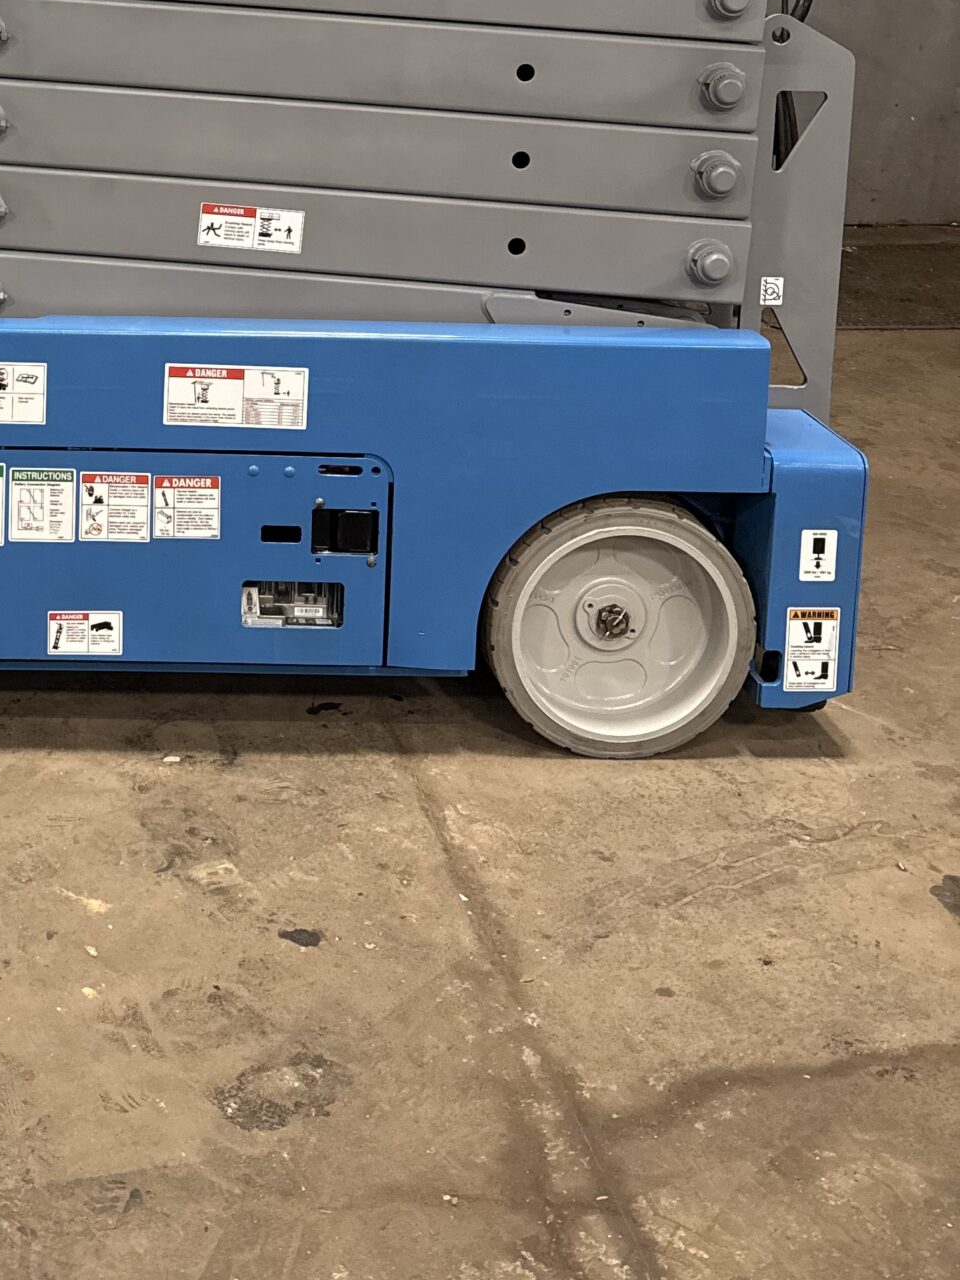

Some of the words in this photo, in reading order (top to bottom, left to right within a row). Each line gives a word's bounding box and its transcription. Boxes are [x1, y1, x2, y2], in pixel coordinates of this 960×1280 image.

[219, 207, 245, 215] DANGER
[195, 368, 228, 378] DANGER
[14, 471, 72, 481] INSTRUCTIONS
[101, 475, 137, 484] DANGER
[172, 478, 212, 488] DANGER
[800, 611, 835, 619] WARNING
